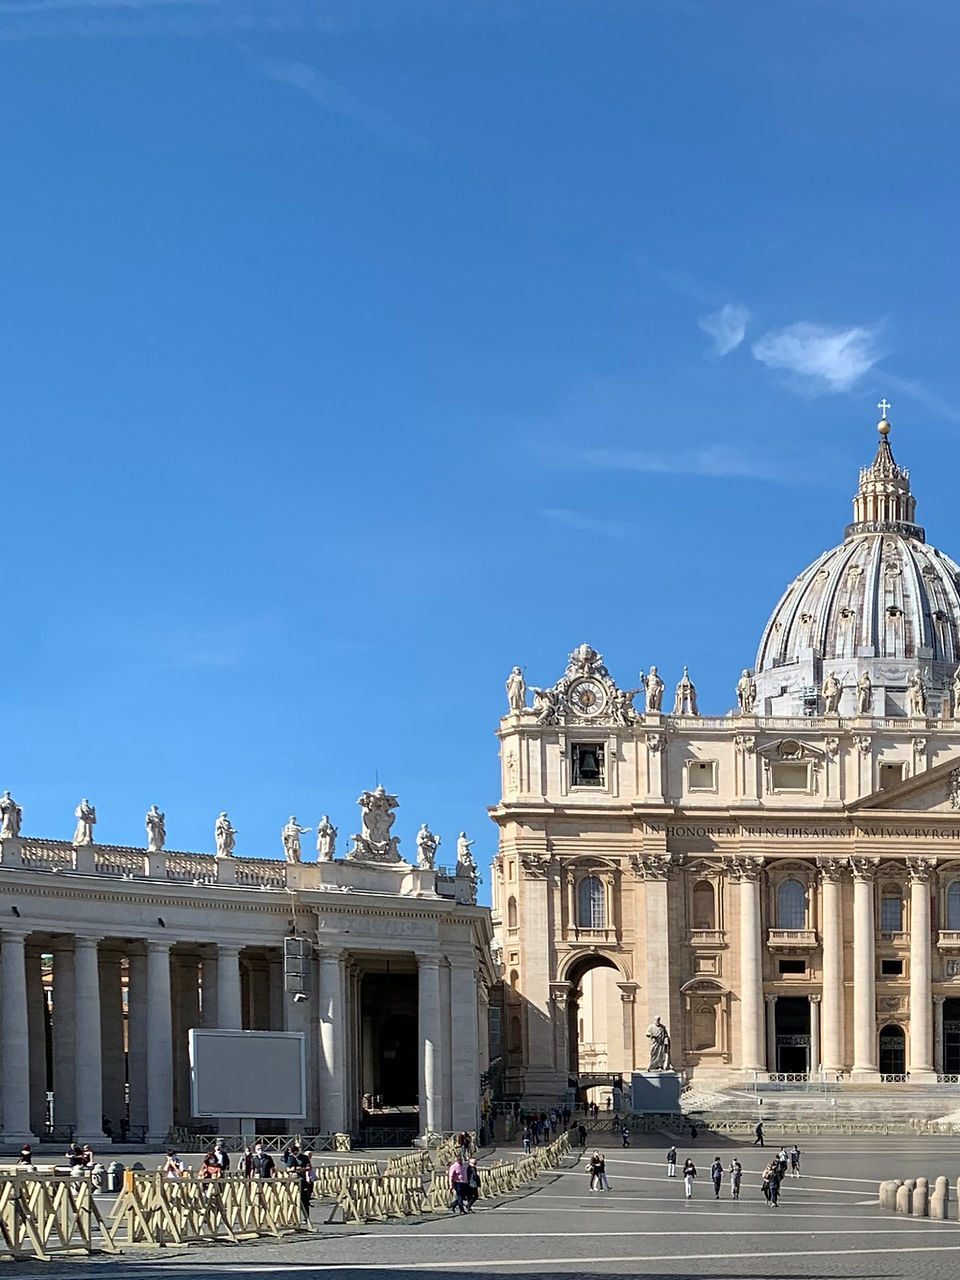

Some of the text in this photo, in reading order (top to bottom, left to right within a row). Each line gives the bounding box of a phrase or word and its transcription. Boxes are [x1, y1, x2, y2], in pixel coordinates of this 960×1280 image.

[666, 826, 736, 838] HONOREM
[741, 827, 809, 838] PRINCIPIS
[813, 828, 852, 839] APOST
[856, 827, 901, 839] PAVLVS
